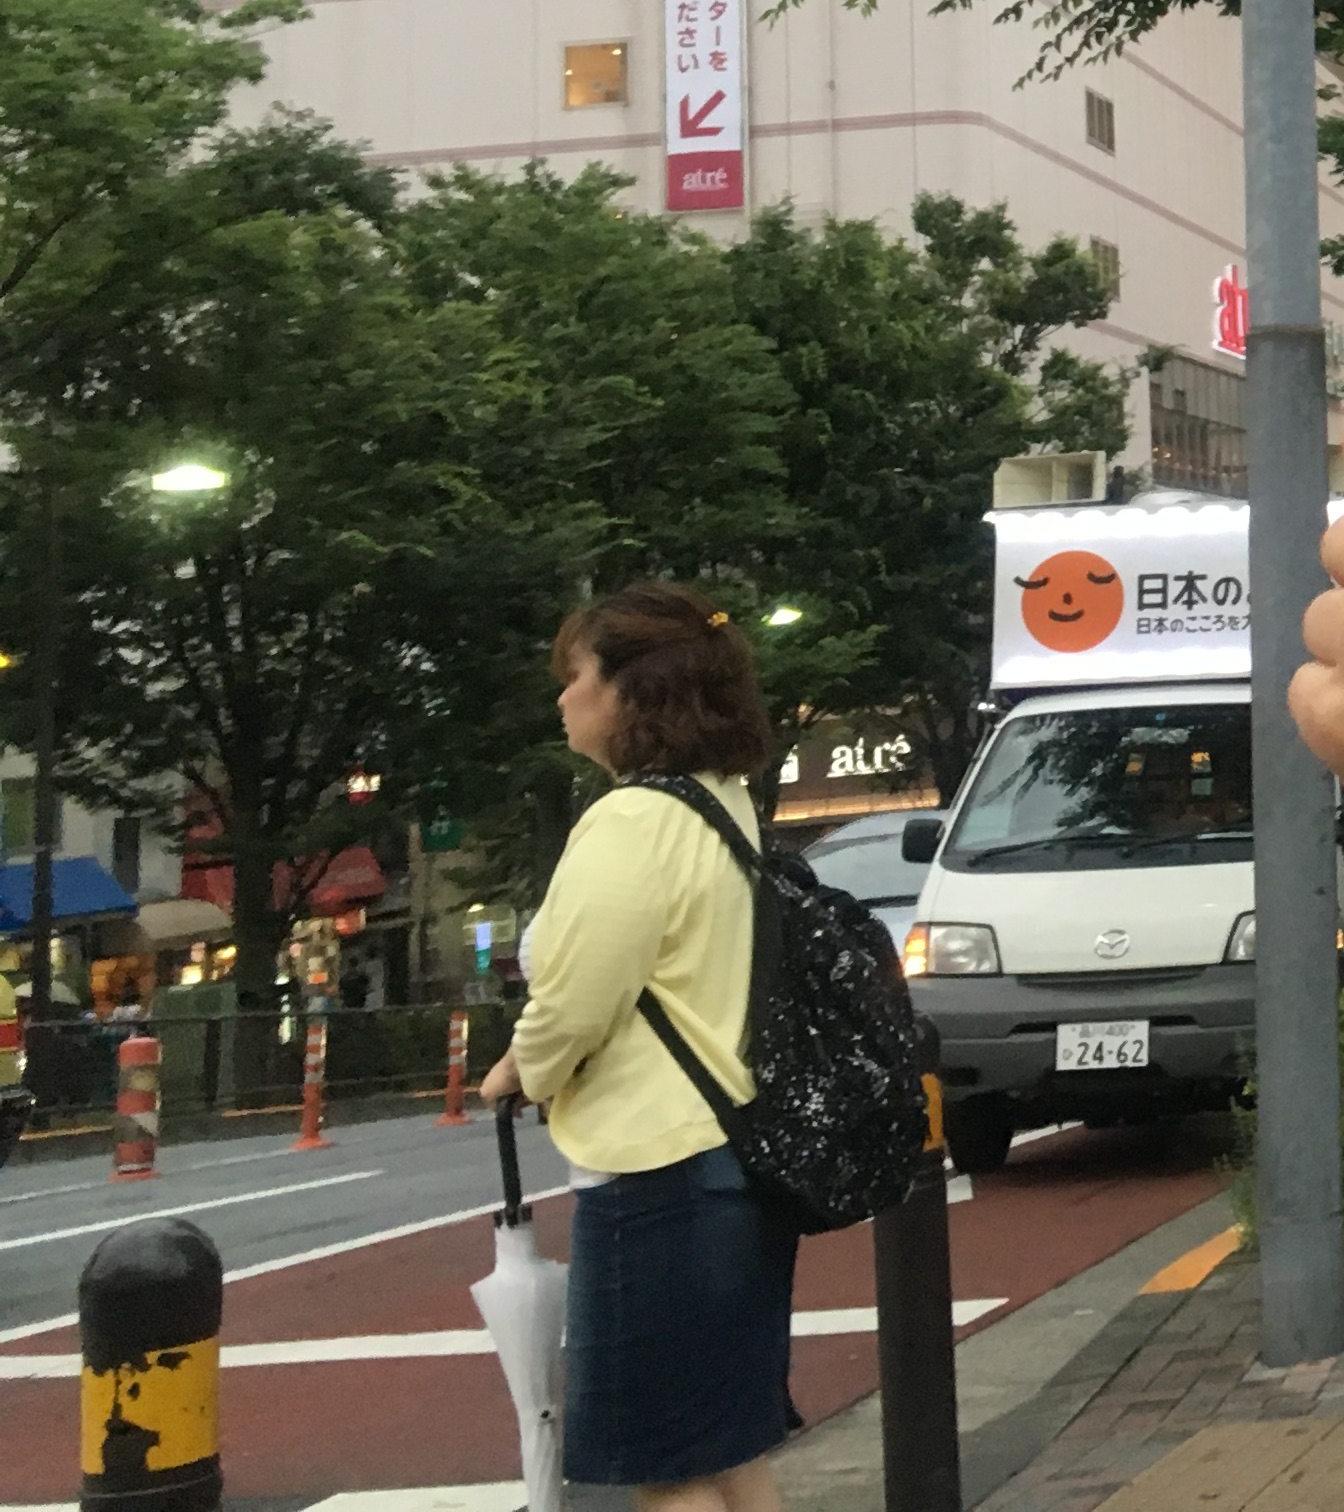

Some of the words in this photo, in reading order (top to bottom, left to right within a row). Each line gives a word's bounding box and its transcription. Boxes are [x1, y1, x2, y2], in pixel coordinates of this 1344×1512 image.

[681, 167, 730, 192] atré
[1138, 570, 1251, 612] 日本の
[1077, 1039, 1145, 1066] 24-62
